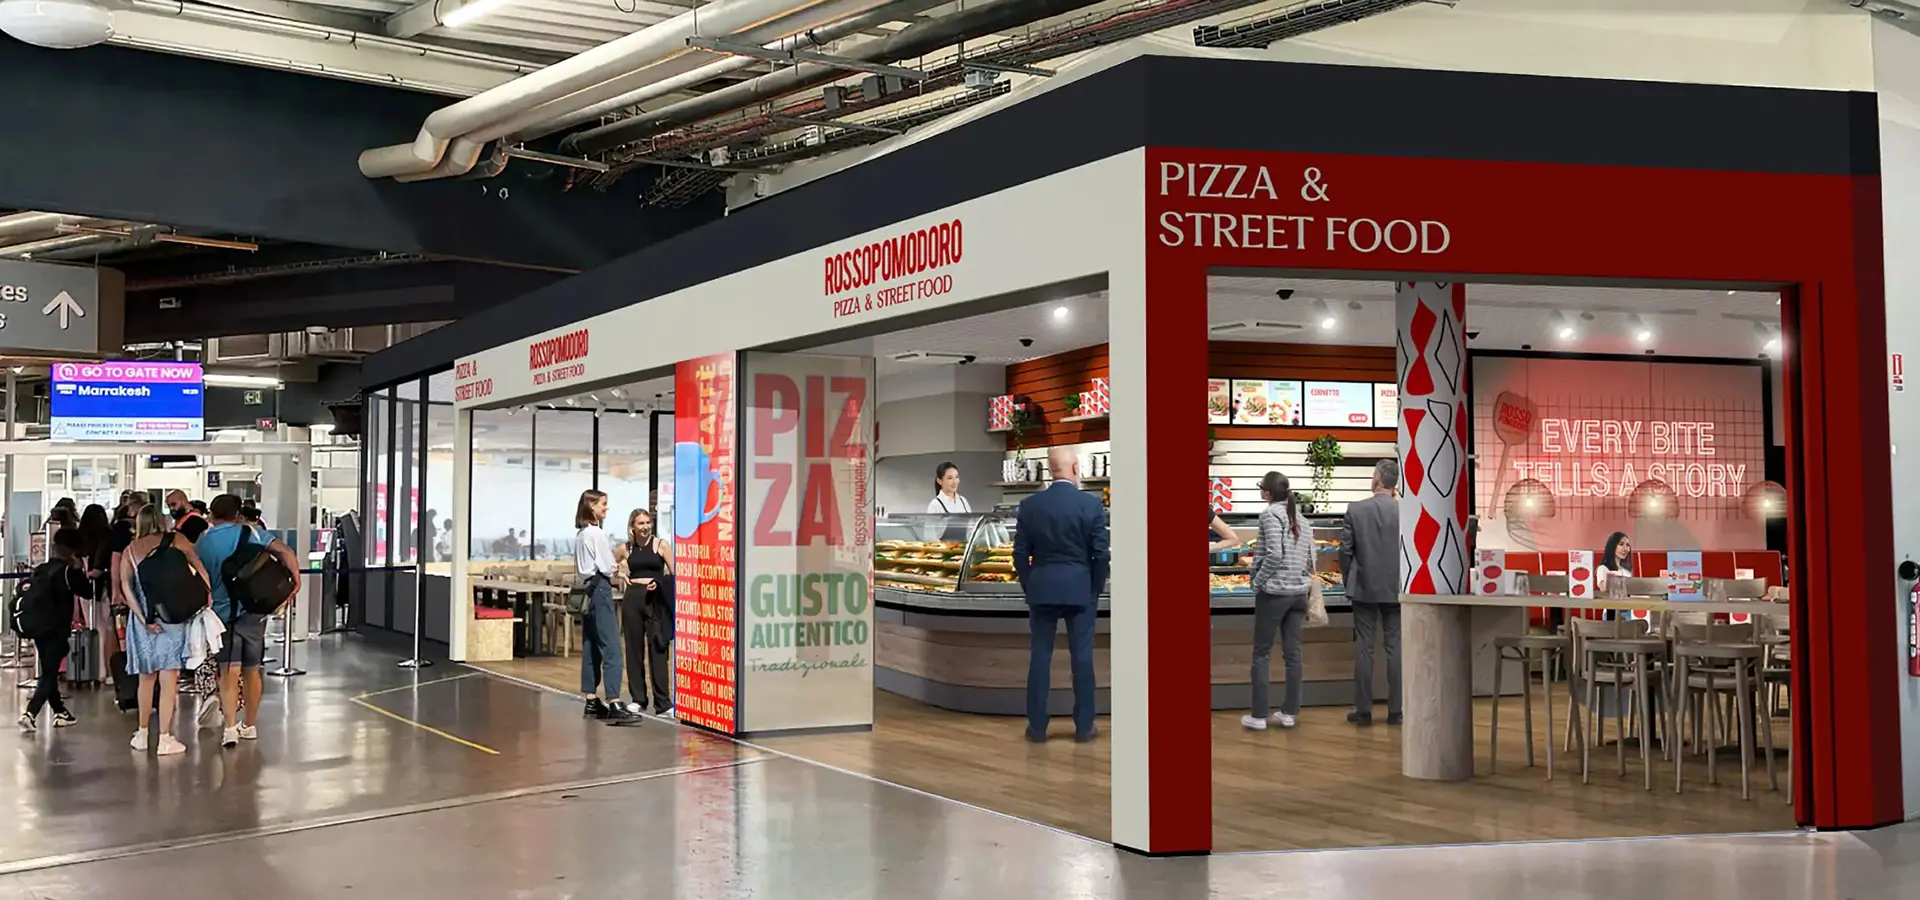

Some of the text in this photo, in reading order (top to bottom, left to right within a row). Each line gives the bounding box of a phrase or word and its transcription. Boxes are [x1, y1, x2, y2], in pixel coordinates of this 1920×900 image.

[1160, 162, 1330, 202] PIZZA &
[1159, 211, 1450, 254] STREET FOOD
[825, 219, 962, 296] ROSSOPOMODORO
[834, 274, 953, 319] PIZZA & STREET FOOD
[530, 328, 588, 371] ROSSOPOMODORO
[82, 367, 102, 377] GO
[106, 367, 123, 378] TO
[125, 367, 159, 378] GATE
[161, 367, 193, 378] NOW
[456, 360, 477, 380] PIZZA &
[534, 372, 546, 386] PIZZA
[552, 367, 568, 381] STREET
[569, 363, 585, 378] FOOD
[78, 385, 151, 397] Marrakesh
[456, 378, 493, 402] STREET FOOD
[754, 373, 867, 458] PIZ
[1542, 418, 1715, 455] EVERY BITE
[1513, 461, 1746, 498] TELLS A STORY
[754, 462, 844, 546] ZA
[688, 544, 710, 560] STORIA
[693, 563, 726, 581] RACCONTA
[700, 583, 717, 599] OGNI
[750, 572, 868, 618] GUSTO
[702, 604, 716, 619] UNA
[687, 619, 709, 637] MORSO
[750, 620, 868, 648] AUTENTICO
[687, 639, 708, 656] STORIA
[693, 659, 726, 680] RACCONTA
[748, 653, 867, 678] Tradizionale
[700, 680, 717, 697] OGNI
[702, 699, 716, 716] UNA
